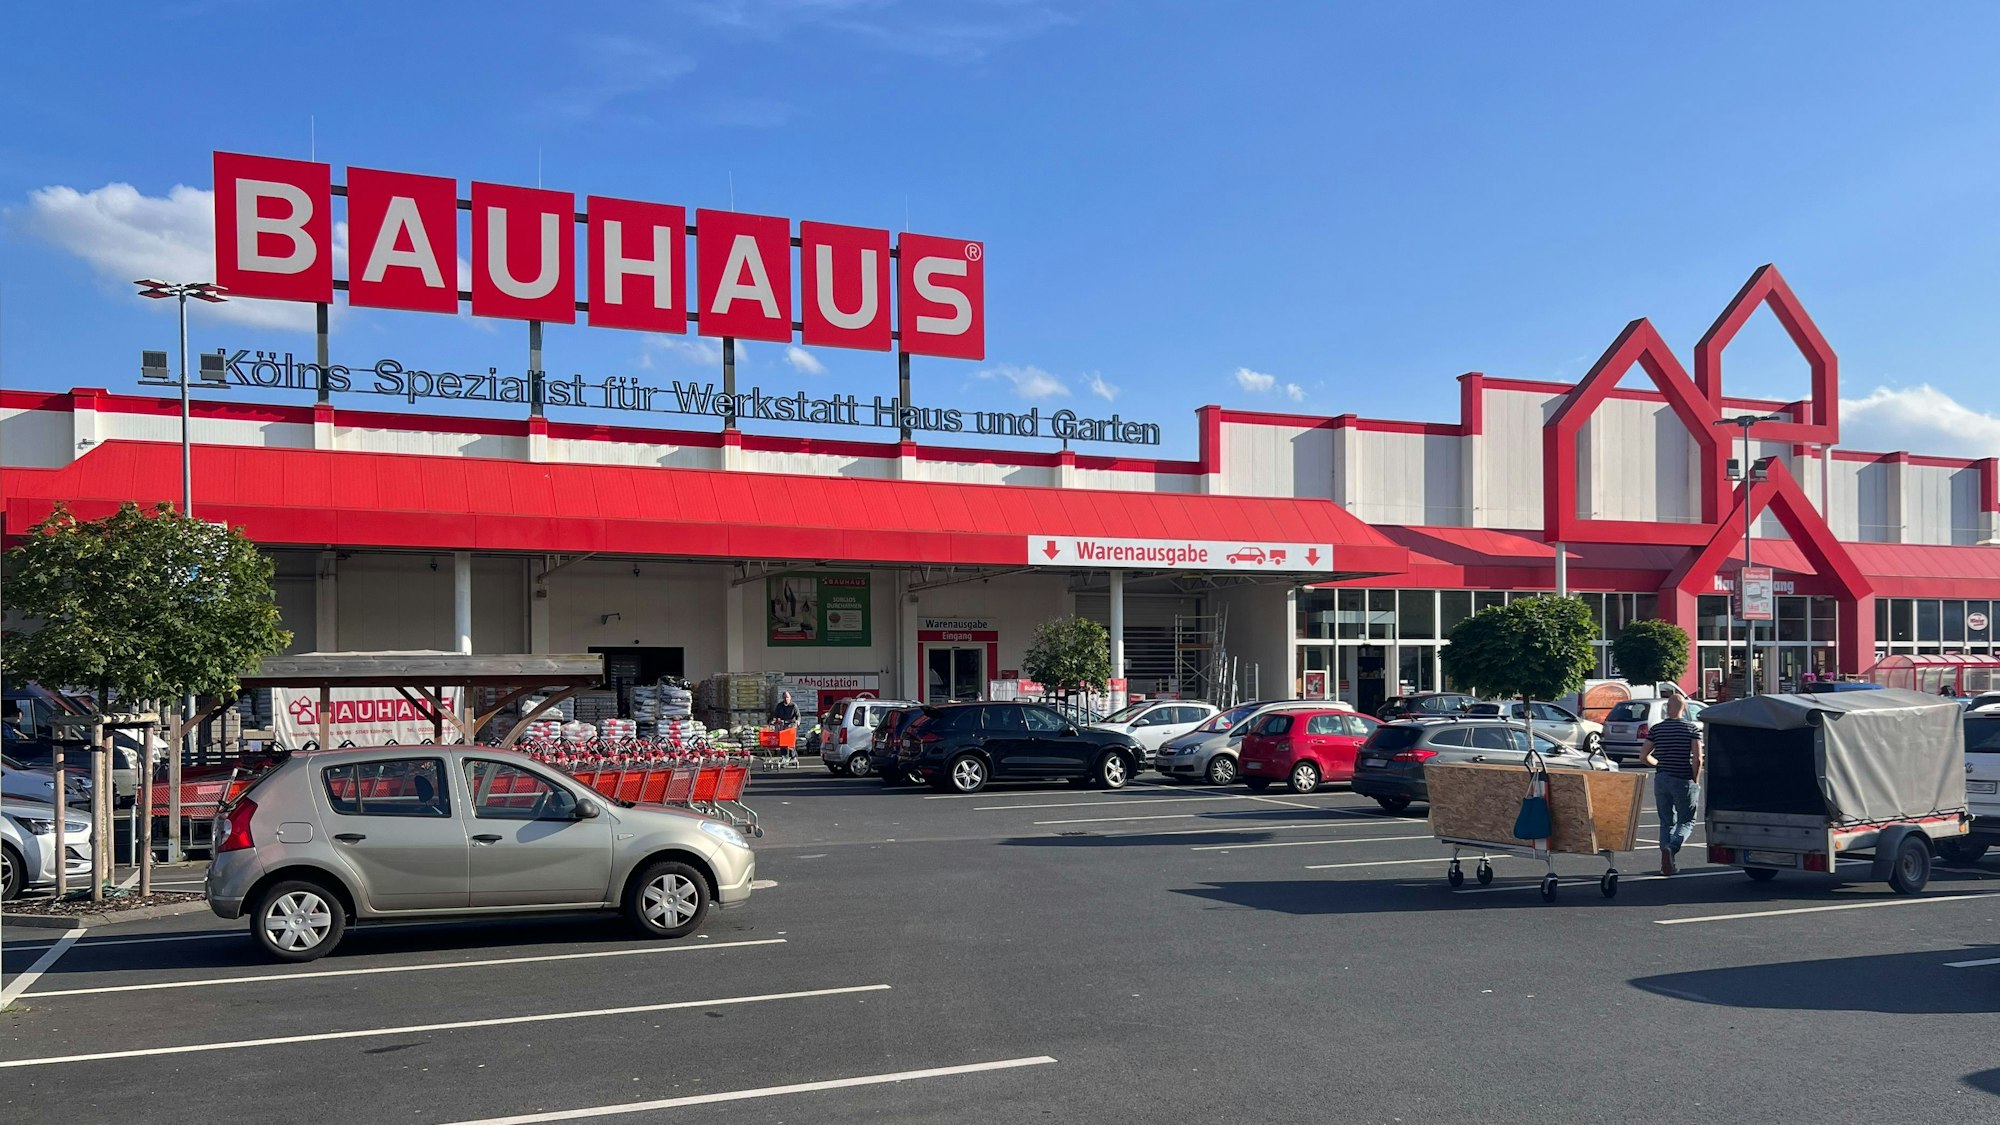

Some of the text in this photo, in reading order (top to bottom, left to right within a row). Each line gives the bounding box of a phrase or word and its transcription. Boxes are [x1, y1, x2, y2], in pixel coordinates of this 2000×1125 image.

[217, 348, 1160, 445] Kölns Spezialist für Werkstatt Haus und Garten
[1076, 541, 1208, 566] Warenausgabe
[925, 619, 988, 631] Warenausgabe
[942, 632, 973, 641] Eingang
